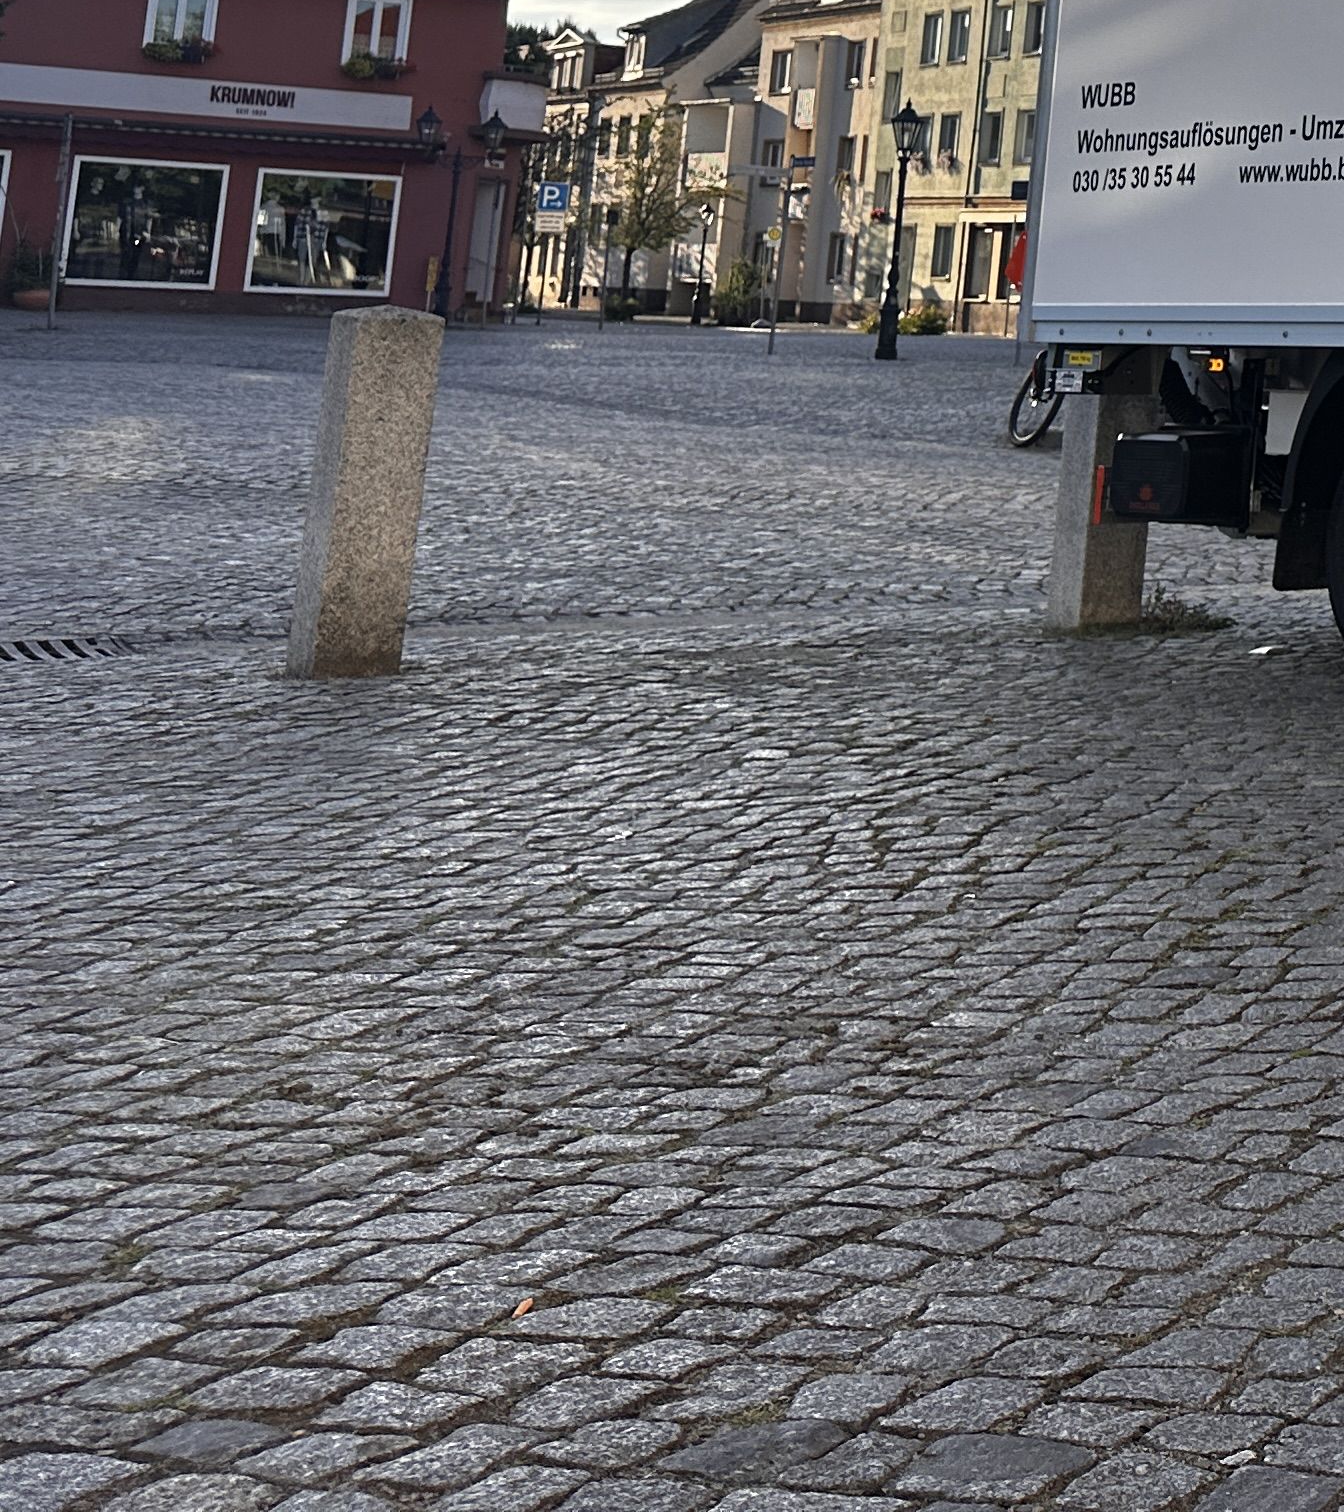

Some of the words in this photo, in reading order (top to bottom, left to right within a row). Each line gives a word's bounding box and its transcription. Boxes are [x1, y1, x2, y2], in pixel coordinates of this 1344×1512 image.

[1081, 81, 1136, 109] WUBB
[1077, 121, 1283, 155] Wohnungsauflösungen
[1072, 169, 1099, 193] 030
[1130, 166, 1150, 189] 30
[1154, 164, 1173, 188] 55
[1176, 162, 1196, 186] 44
[542, 185, 560, 208] P
